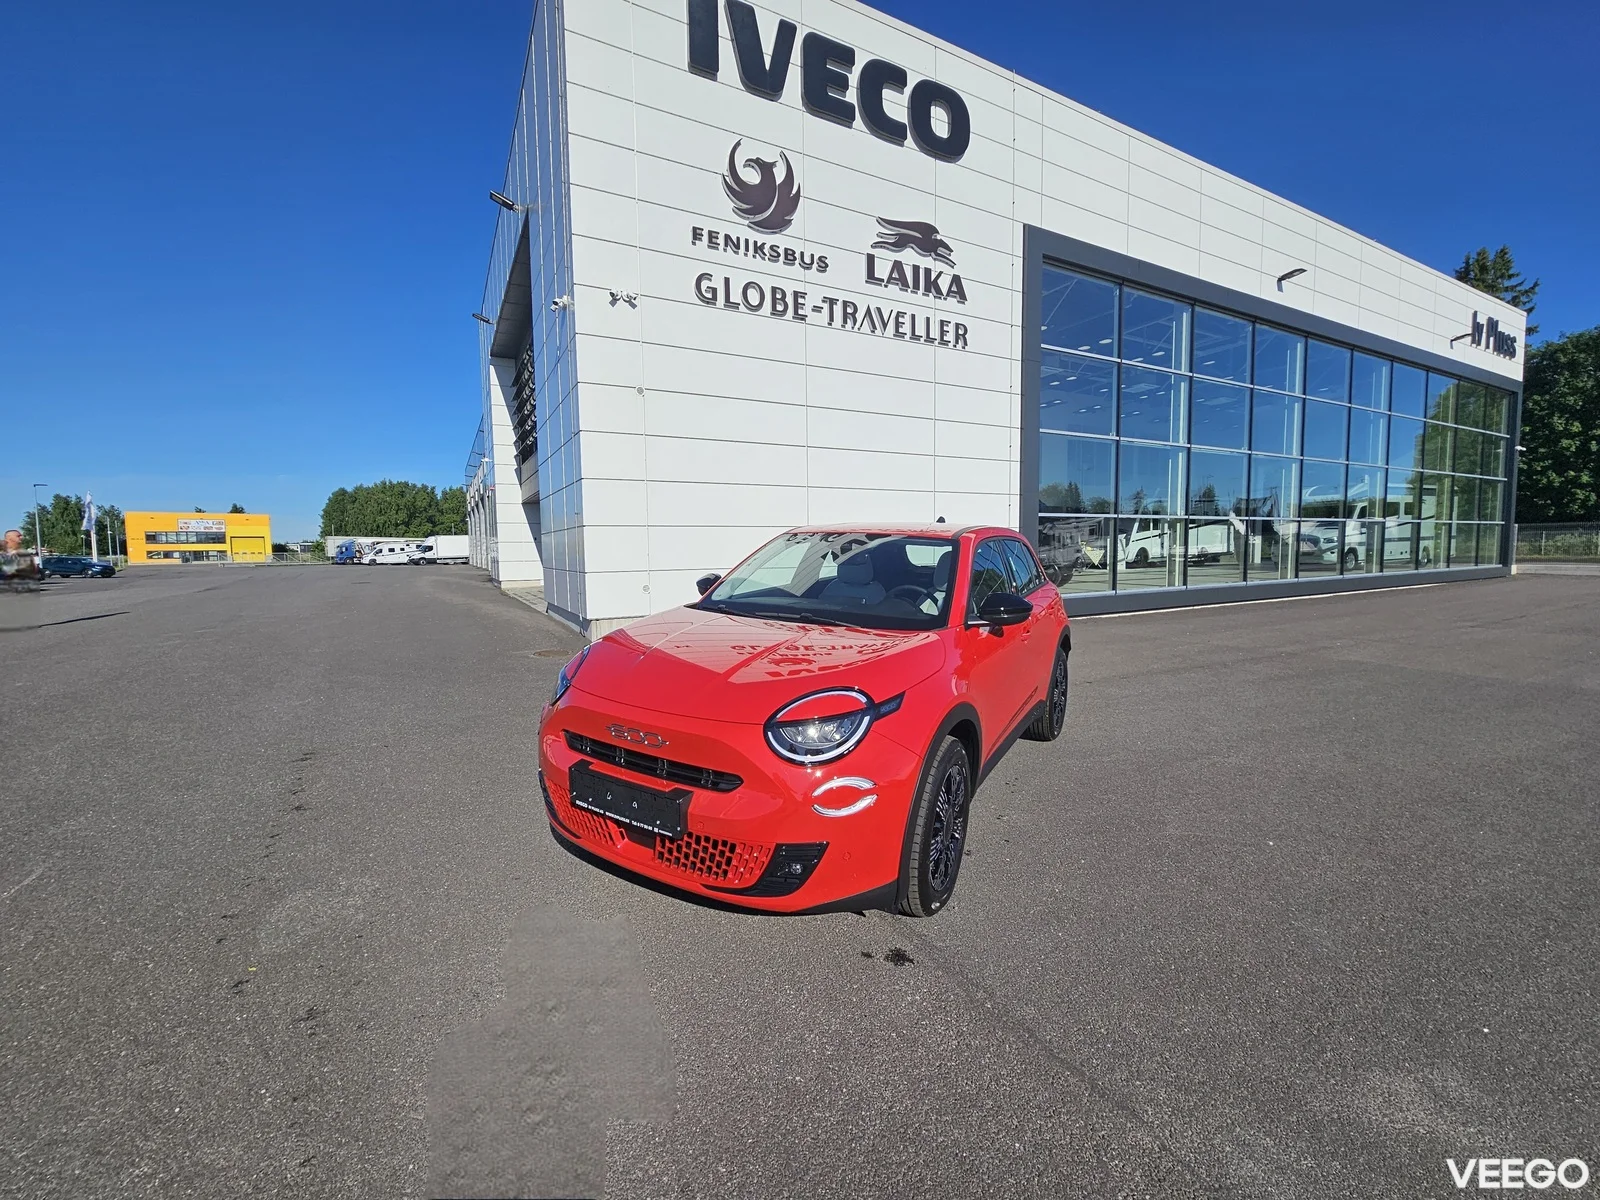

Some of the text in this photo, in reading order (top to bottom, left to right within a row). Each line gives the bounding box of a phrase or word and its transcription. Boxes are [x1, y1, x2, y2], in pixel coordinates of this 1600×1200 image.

[688, 0, 970, 163] IVECO
[691, 226, 829, 273] FENIKSBUS
[866, 252, 967, 305] LAIKA
[694, 272, 969, 350] GLOBE-TRAVELLER
[604, 723, 669, 748] 600
